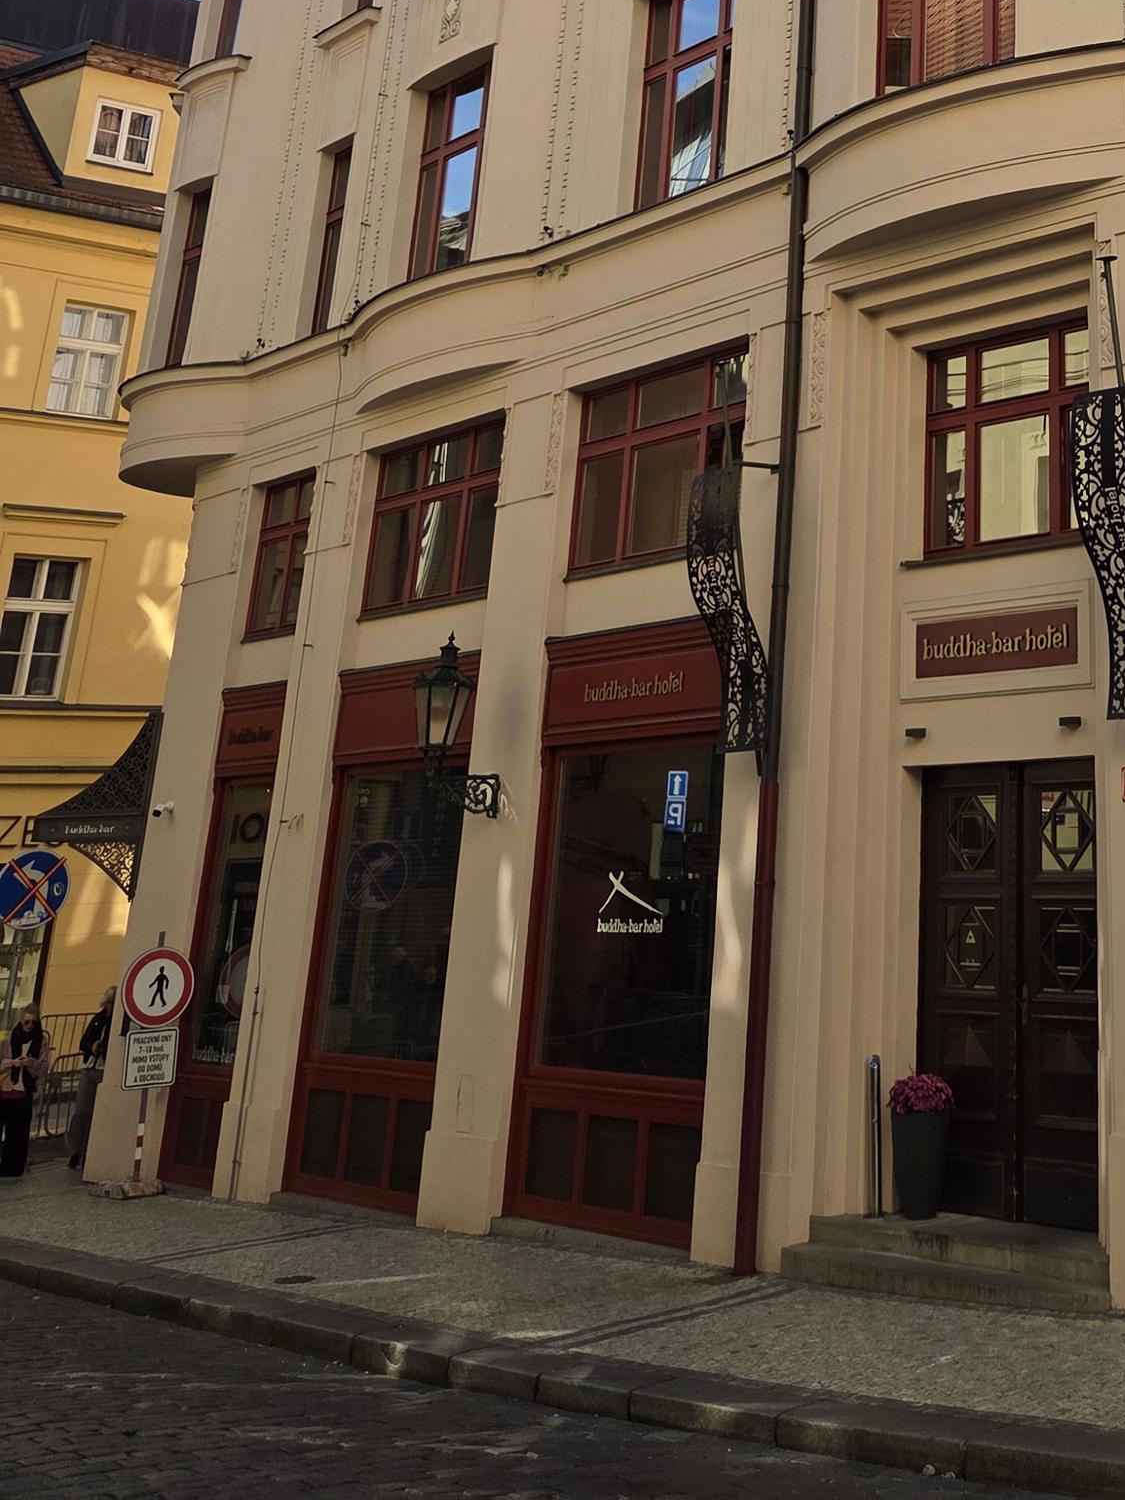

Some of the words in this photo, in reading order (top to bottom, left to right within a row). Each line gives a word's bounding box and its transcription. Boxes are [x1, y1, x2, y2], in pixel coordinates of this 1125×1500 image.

[1104, 486, 1121, 523] hotel
[922, 631, 1022, 661] buddha-bar
[1025, 623, 1069, 650] hotel
[584, 677, 652, 703] buddha-bar
[653, 671, 684, 695] hotel
[597, 918, 643, 933] buddha-bar
[643, 918, 663, 933] hotel
